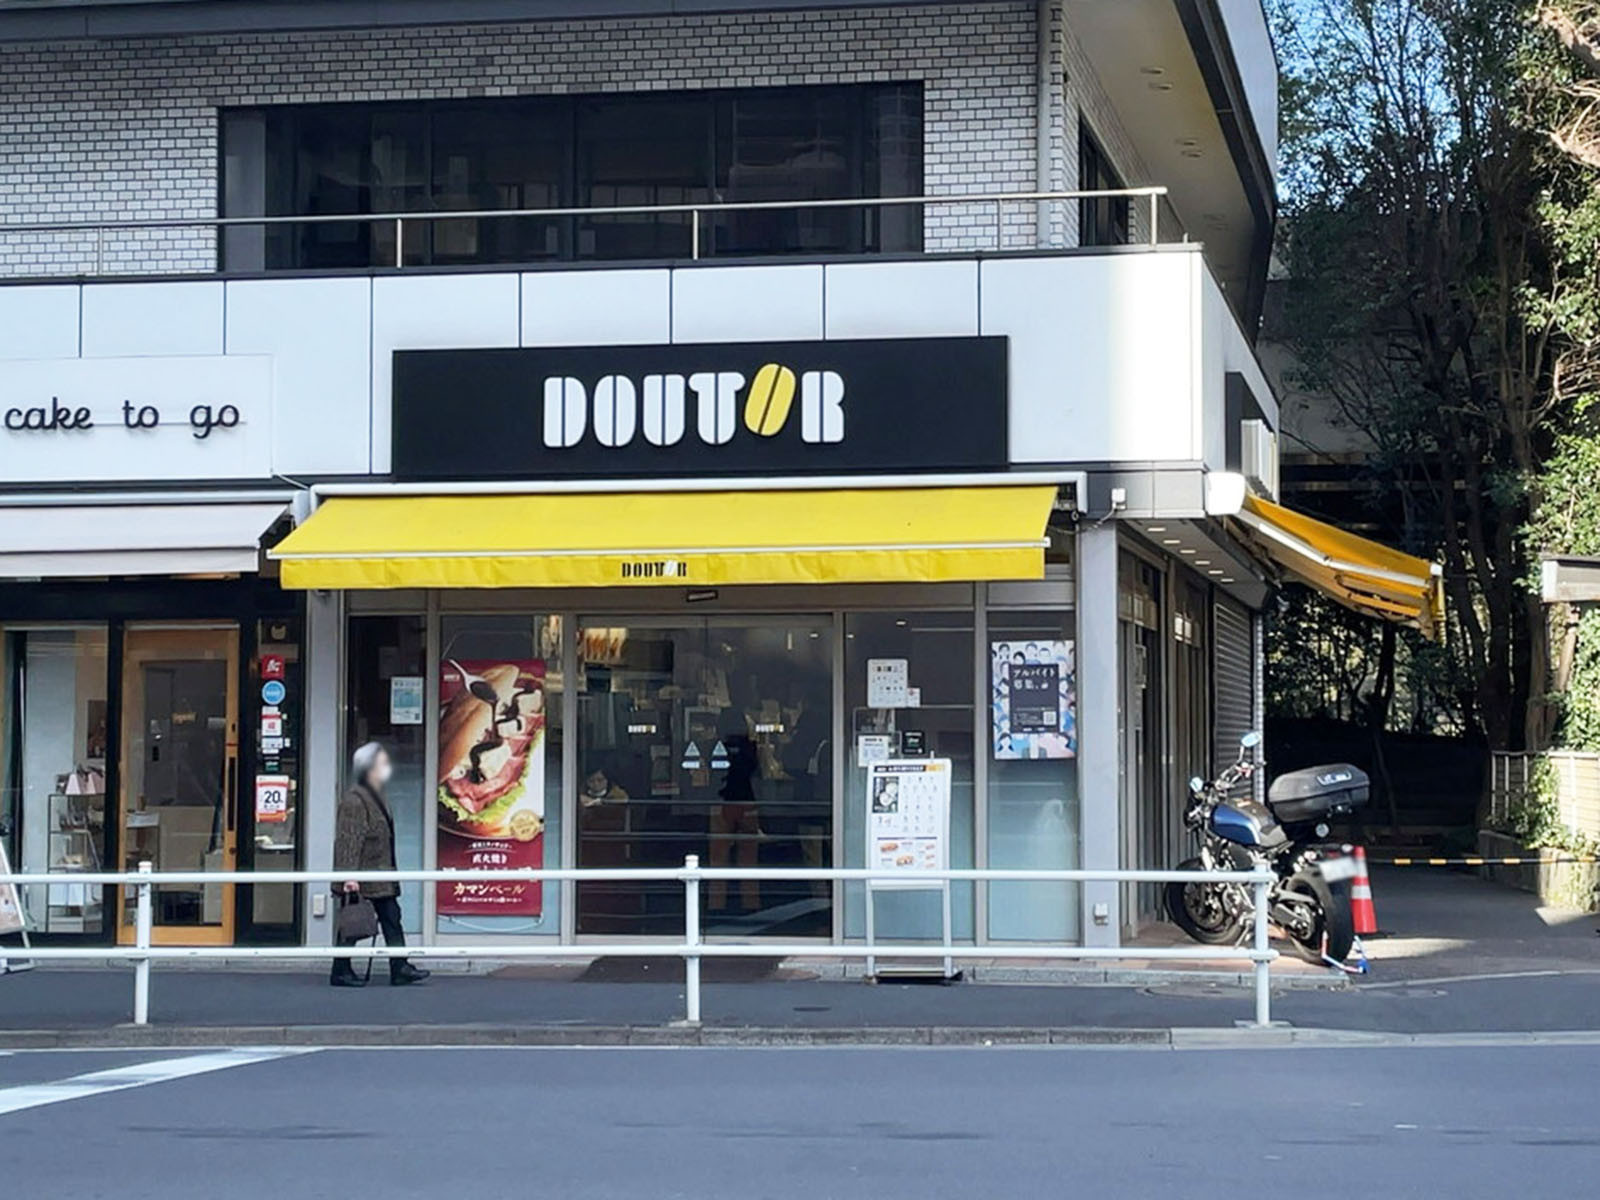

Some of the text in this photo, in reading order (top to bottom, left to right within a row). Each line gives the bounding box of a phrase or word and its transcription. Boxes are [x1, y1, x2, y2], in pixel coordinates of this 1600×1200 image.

[5, 396, 240, 439] cake to go
[543, 362, 845, 448] DOUTOR
[621, 560, 687, 578] DOUTOR
